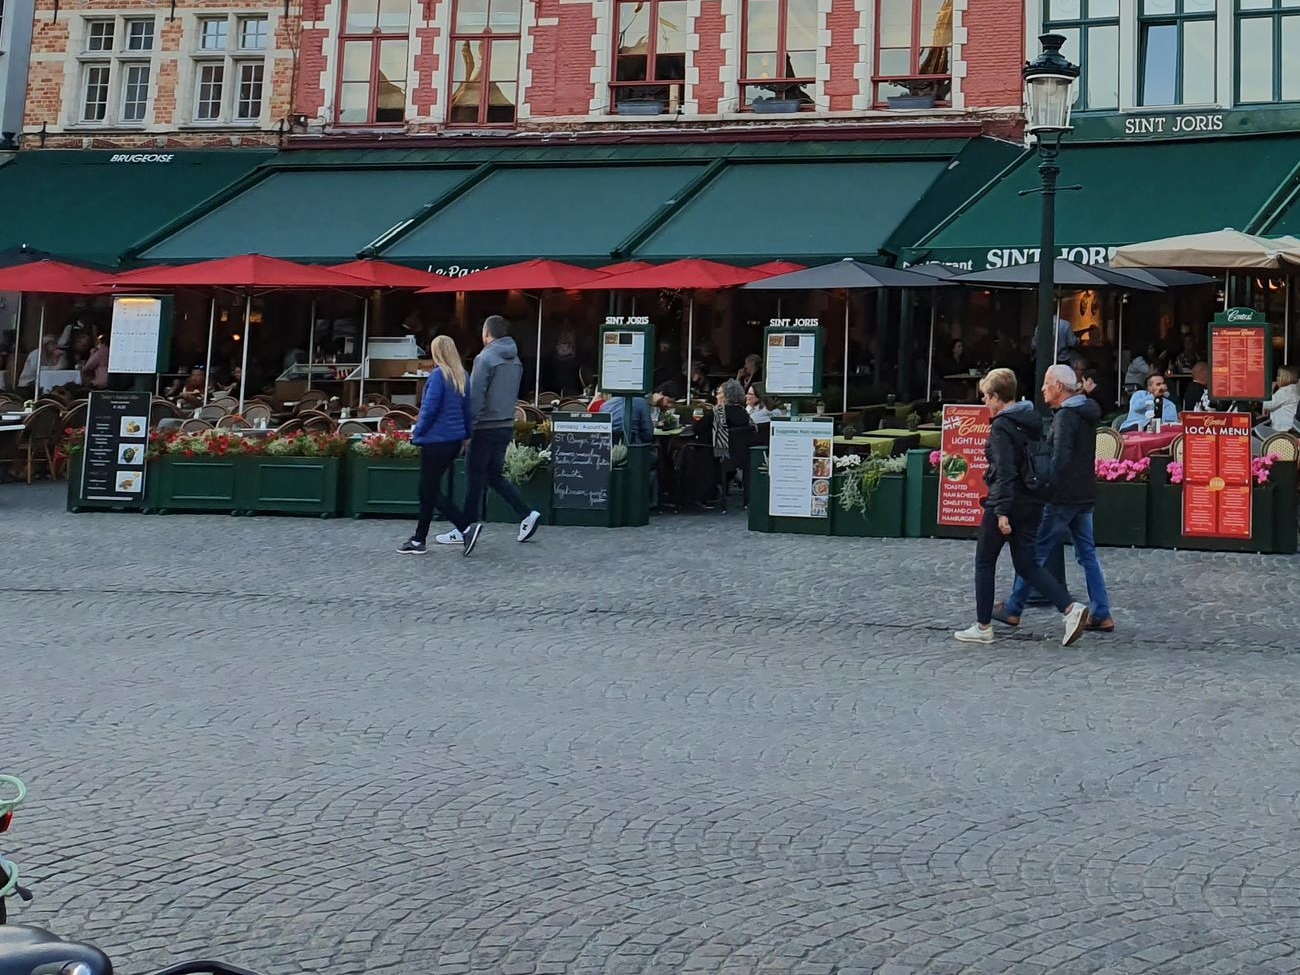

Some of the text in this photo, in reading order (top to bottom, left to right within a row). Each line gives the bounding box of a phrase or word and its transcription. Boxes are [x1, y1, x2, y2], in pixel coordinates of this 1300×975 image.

[1125, 115, 1223, 134] SINT JORIS
[110, 153, 174, 163] BRUGEOISE
[986, 248, 1041, 271] SINT
[1056, 247, 1106, 265] JOR
[1226, 308, 1254, 322] Central
[605, 316, 649, 325] SINT JORIS
[769, 318, 818, 327] SINT JORIS
[958, 416, 992, 436] Centra
[1185, 426, 1249, 436] LOCAL MENU
[951, 437, 973, 445] LIGHT
